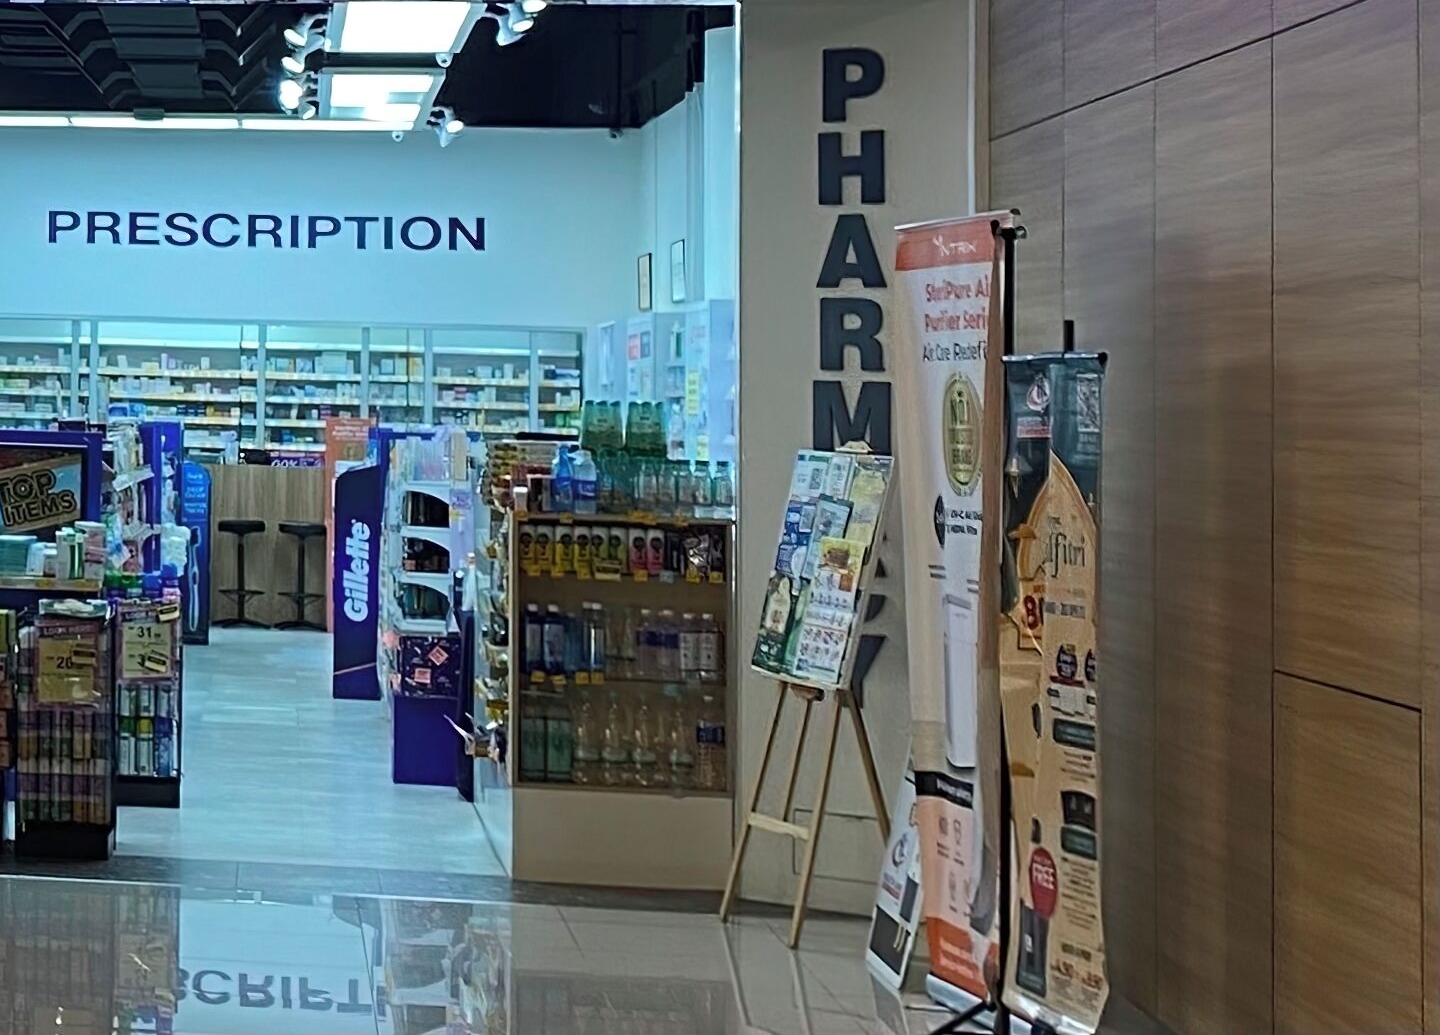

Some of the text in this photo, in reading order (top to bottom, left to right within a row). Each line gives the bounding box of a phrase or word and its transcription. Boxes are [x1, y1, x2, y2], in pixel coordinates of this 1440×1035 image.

[47, 210, 487, 252] PRESCRIPTION
[2, 489, 77, 527] ITEMS
[344, 519, 371, 622] Gillette
[137, 626, 152, 638] 31
